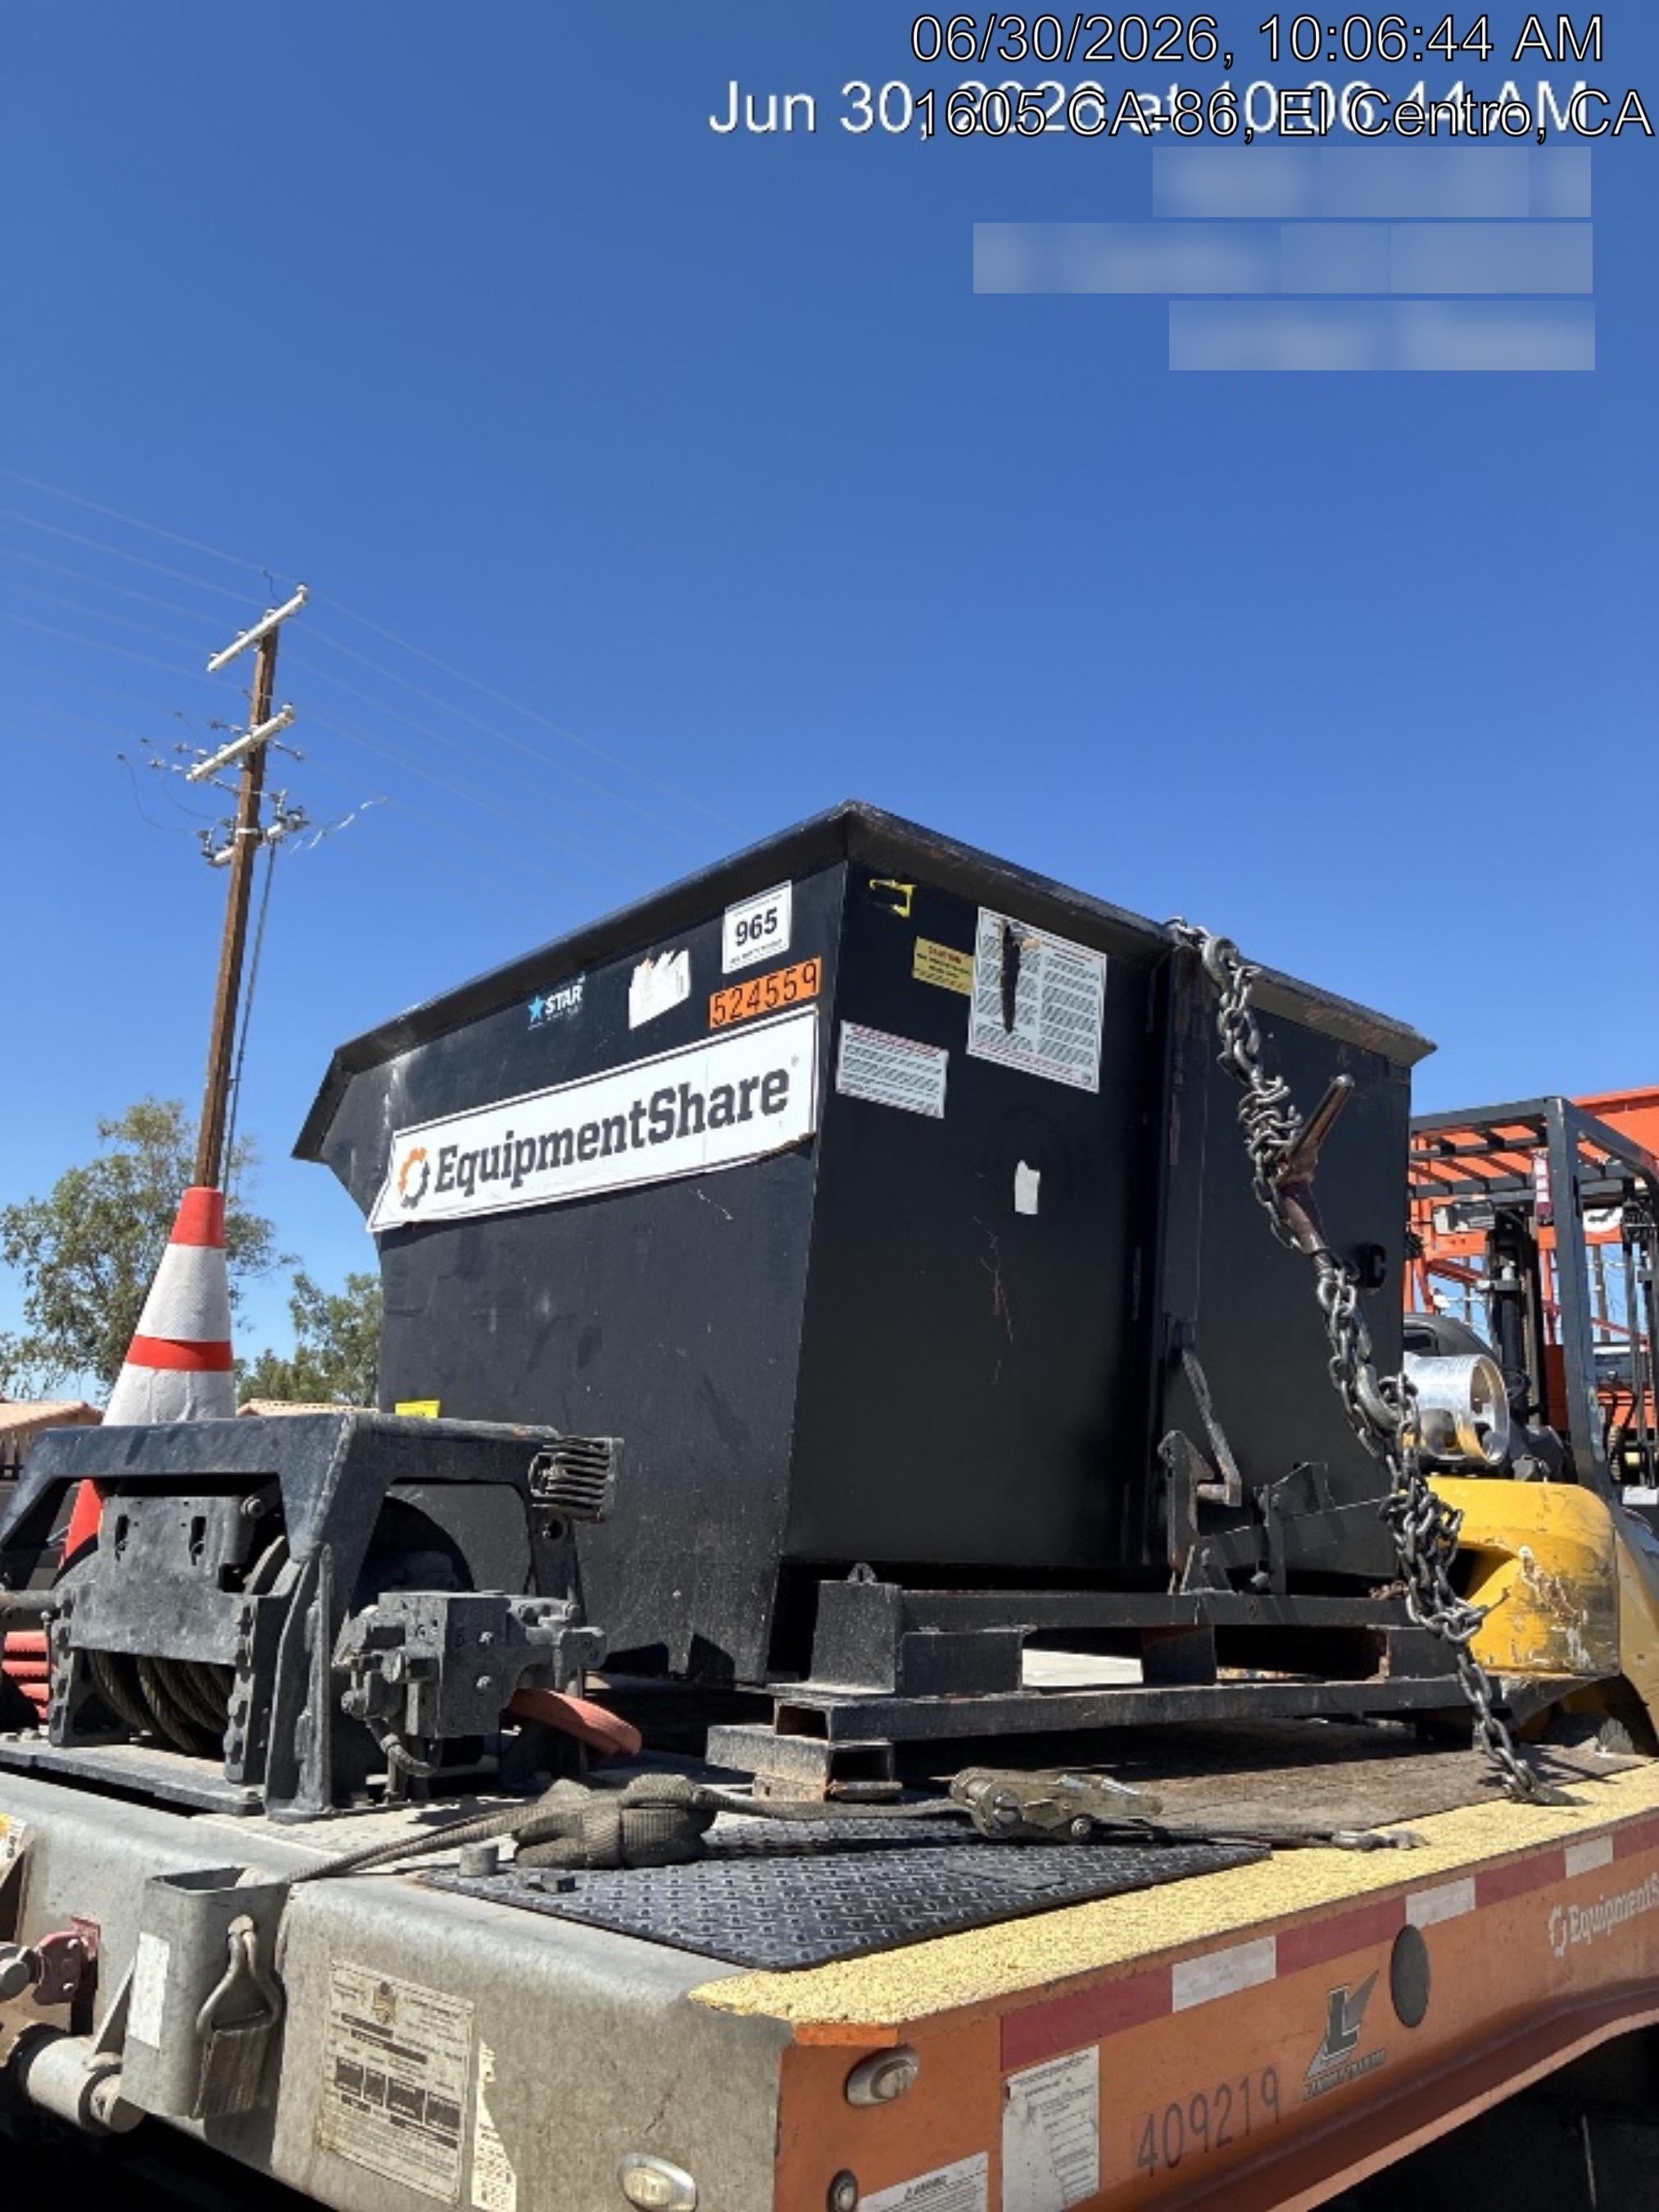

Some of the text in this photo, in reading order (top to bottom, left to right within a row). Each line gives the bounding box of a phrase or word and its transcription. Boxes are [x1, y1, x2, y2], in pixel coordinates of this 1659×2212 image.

[736, 907, 777, 947] 965
[545, 985, 583, 1014] STAR
[712, 962, 818, 1023] 524559
[433, 1067, 790, 1198] EquipmentShare
[1137, 2069, 1280, 2178] 409219
